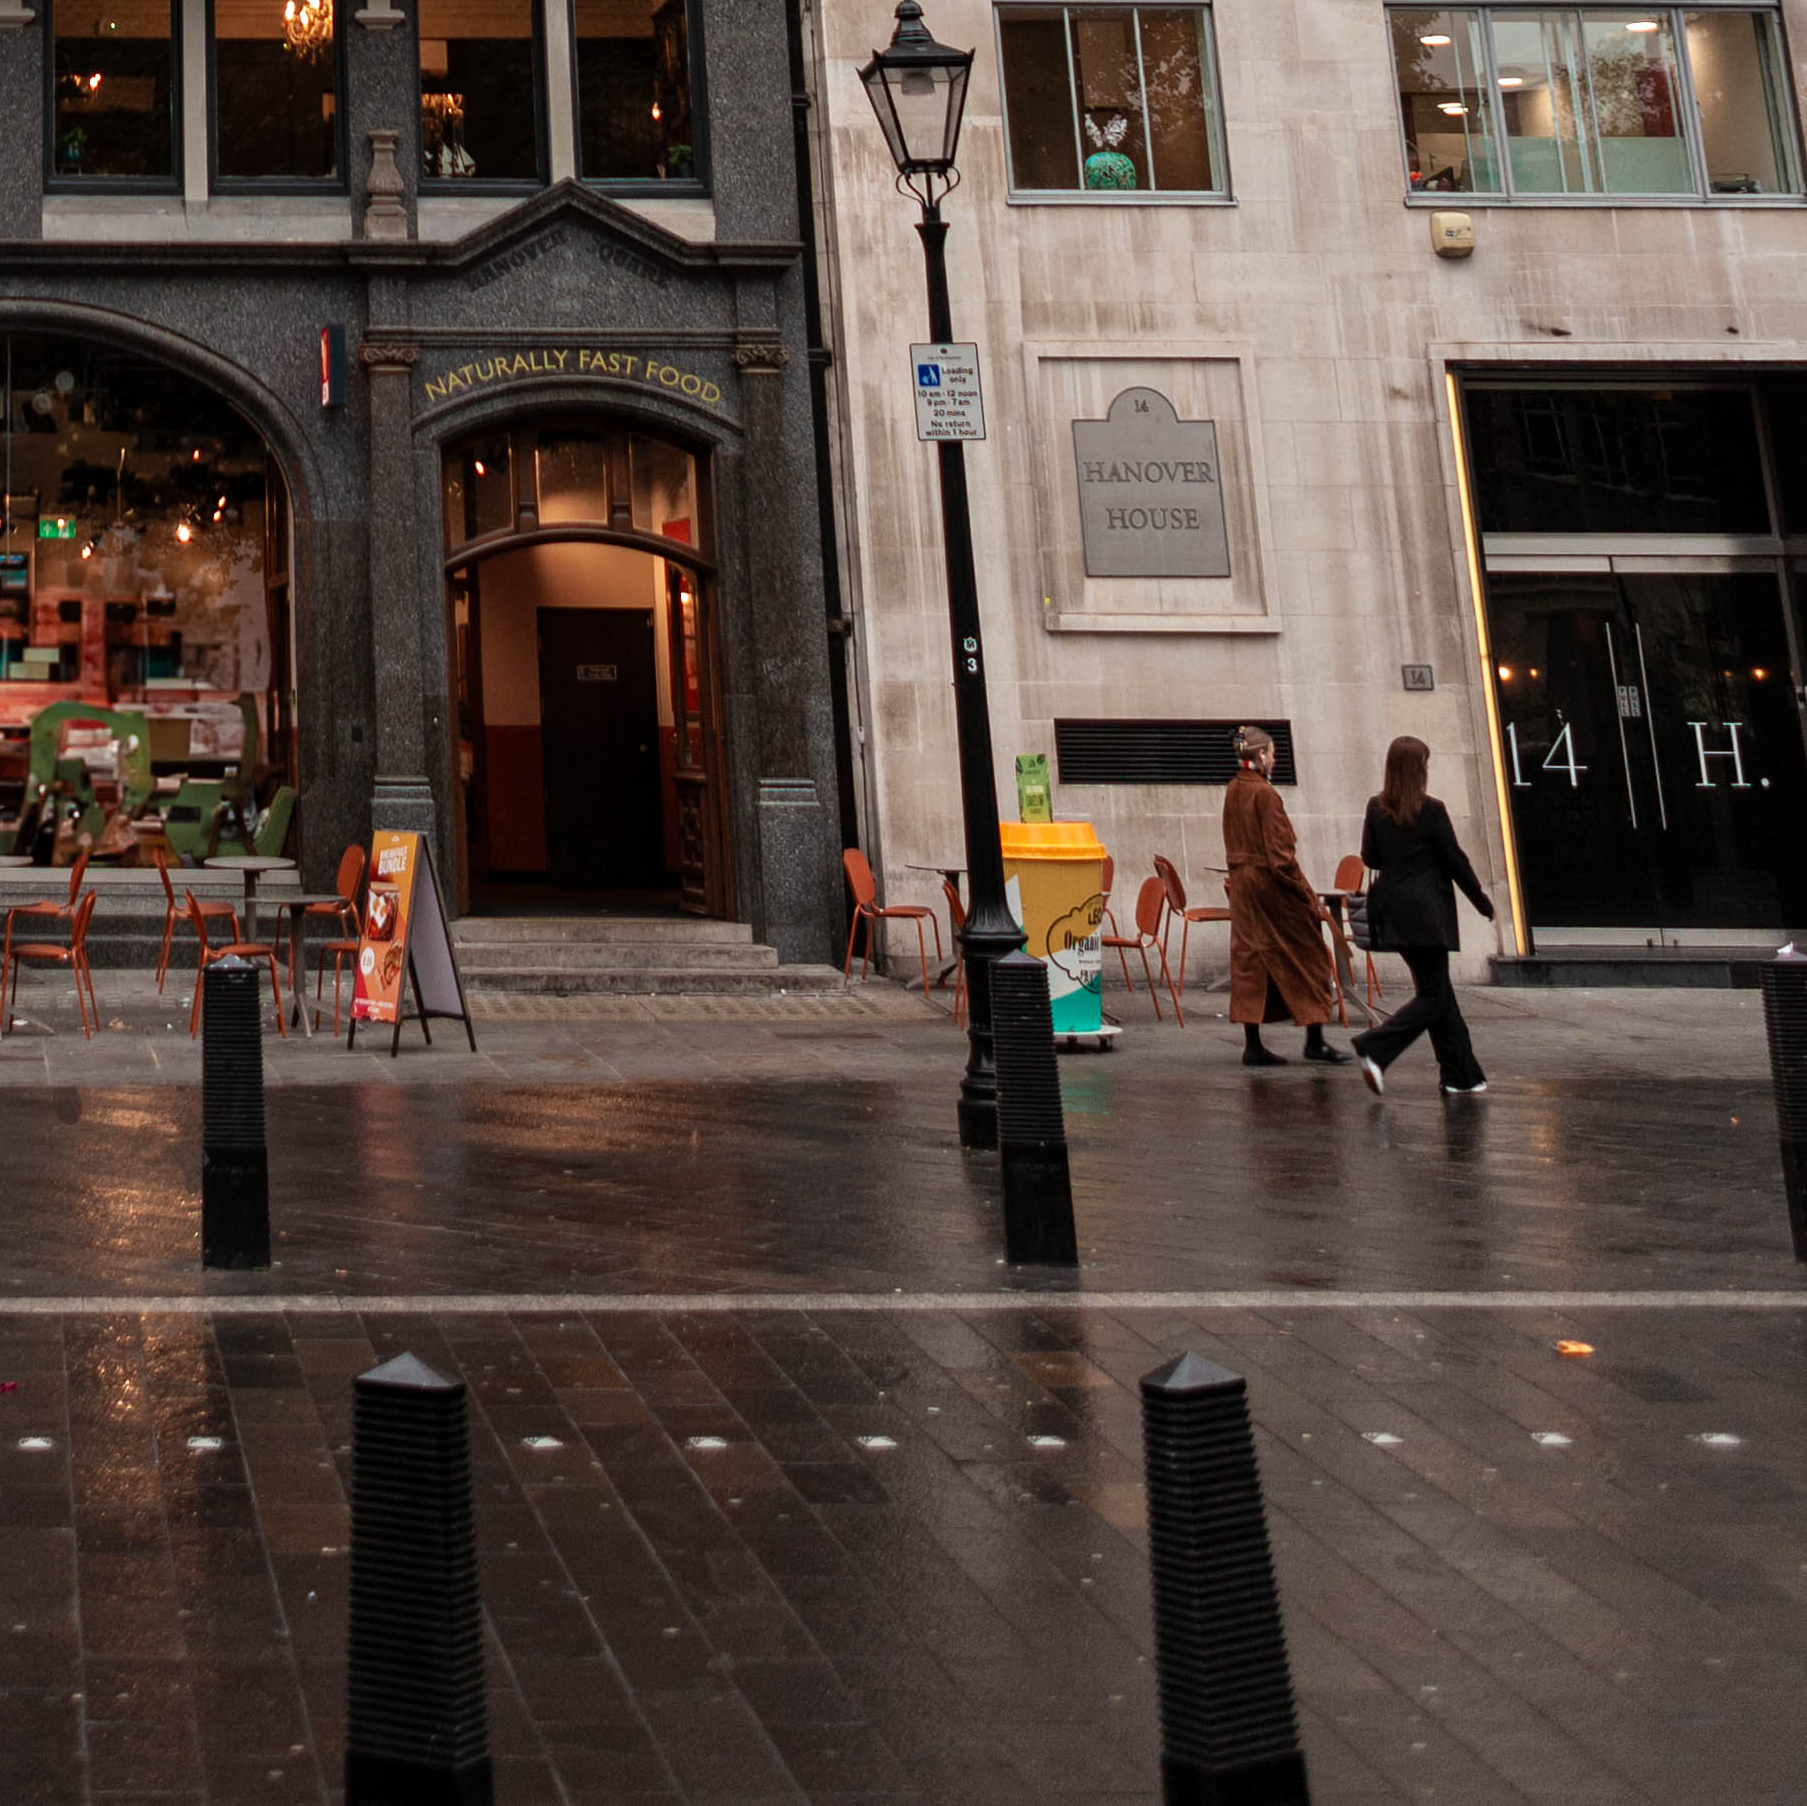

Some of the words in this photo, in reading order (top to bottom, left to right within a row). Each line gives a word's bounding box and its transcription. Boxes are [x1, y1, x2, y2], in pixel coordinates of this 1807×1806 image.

[424, 349, 569, 402] NATURALLY
[578, 349, 638, 376] FAST
[645, 360, 721, 404] FOOD
[941, 367, 973, 375] Loading
[949, 375, 966, 384] only
[1134, 399, 1149, 413] 14
[1083, 461, 1215, 483] HANOVER
[1106, 508, 1200, 530] HOUSE
[967, 657, 978, 673] 3
[1410, 670, 1426, 684] 14
[1506, 721, 1588, 787] 14
